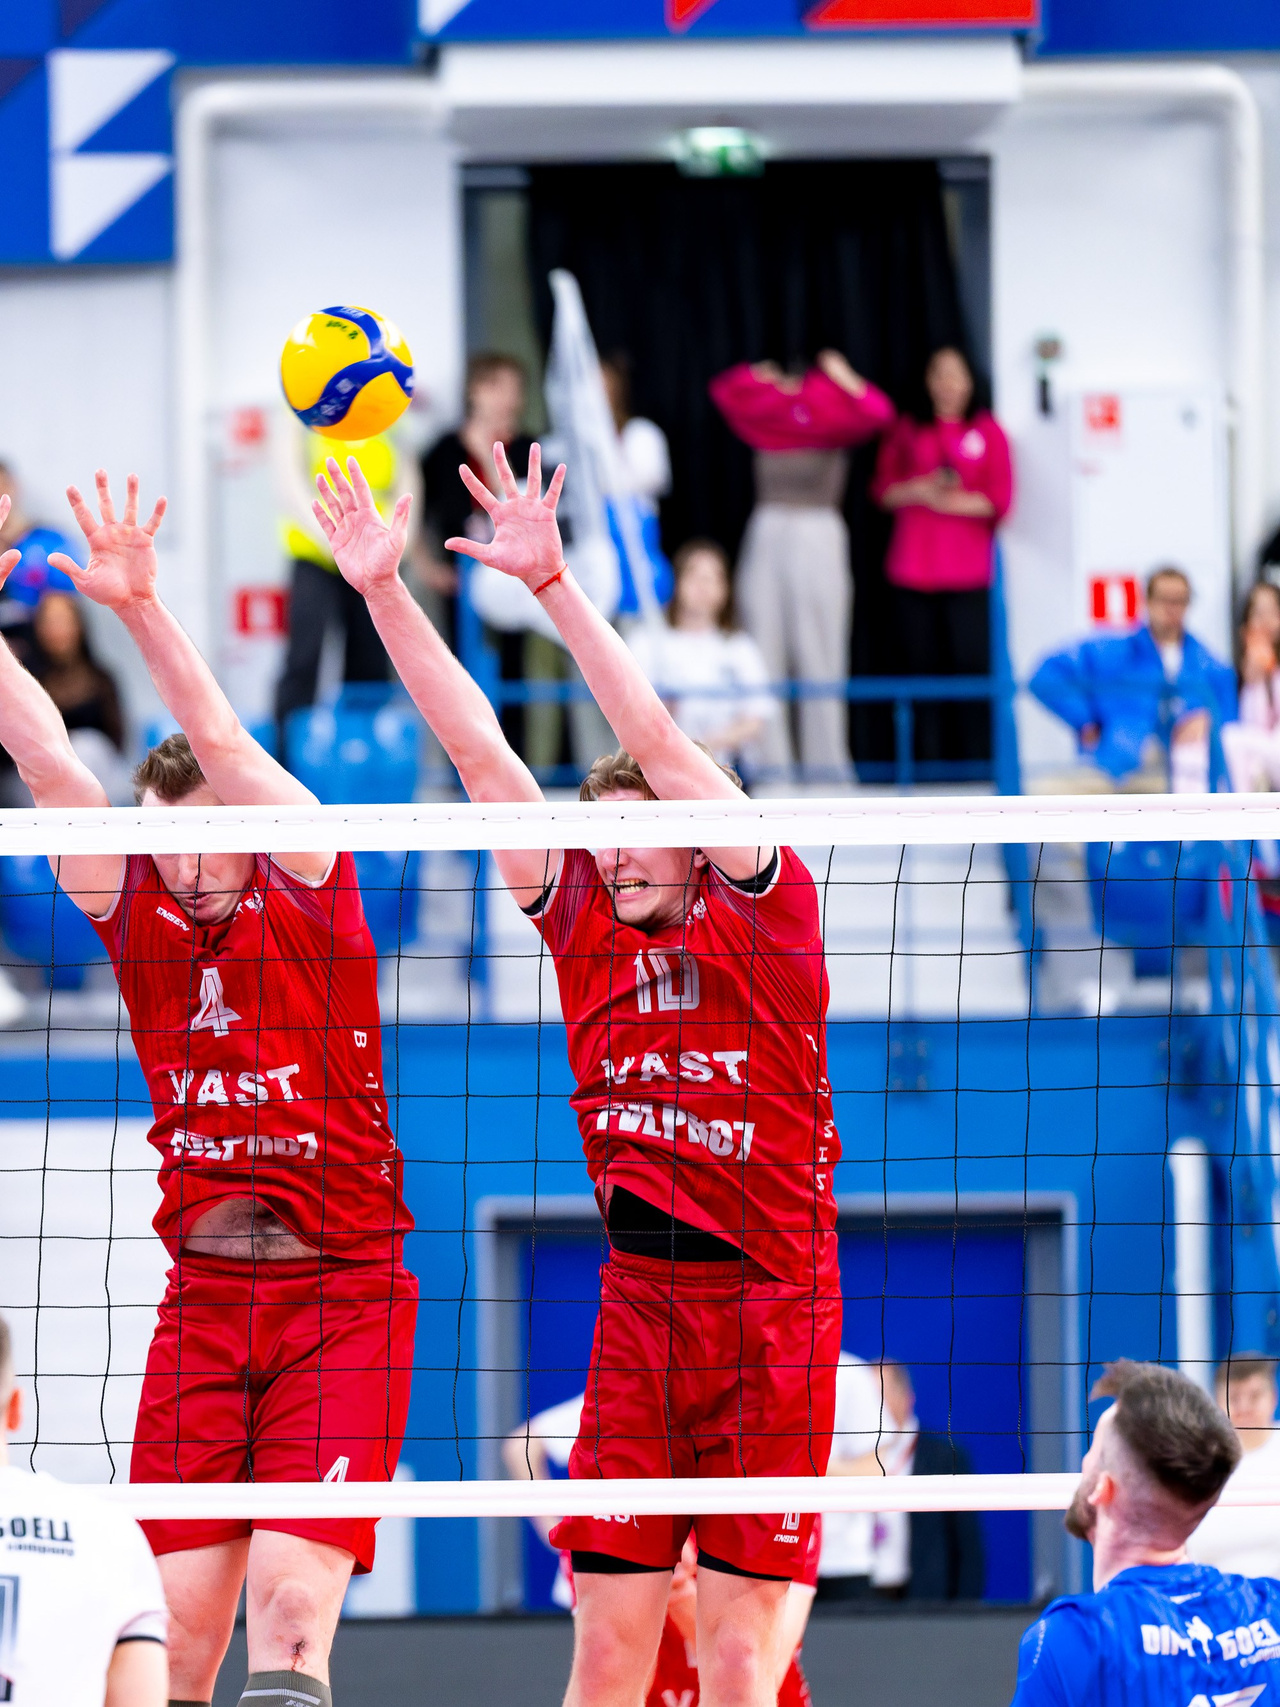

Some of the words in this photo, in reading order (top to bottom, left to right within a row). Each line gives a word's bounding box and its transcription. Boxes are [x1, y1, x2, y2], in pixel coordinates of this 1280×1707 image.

[155, 906, 190, 932] ENSEN
[633, 946, 701, 1014] 10
[191, 966, 242, 1038] 4
[168, 1063, 303, 1107] VAST
[600, 1050, 751, 1087] VAST
[1140, 1624, 1196, 1658] DIM
